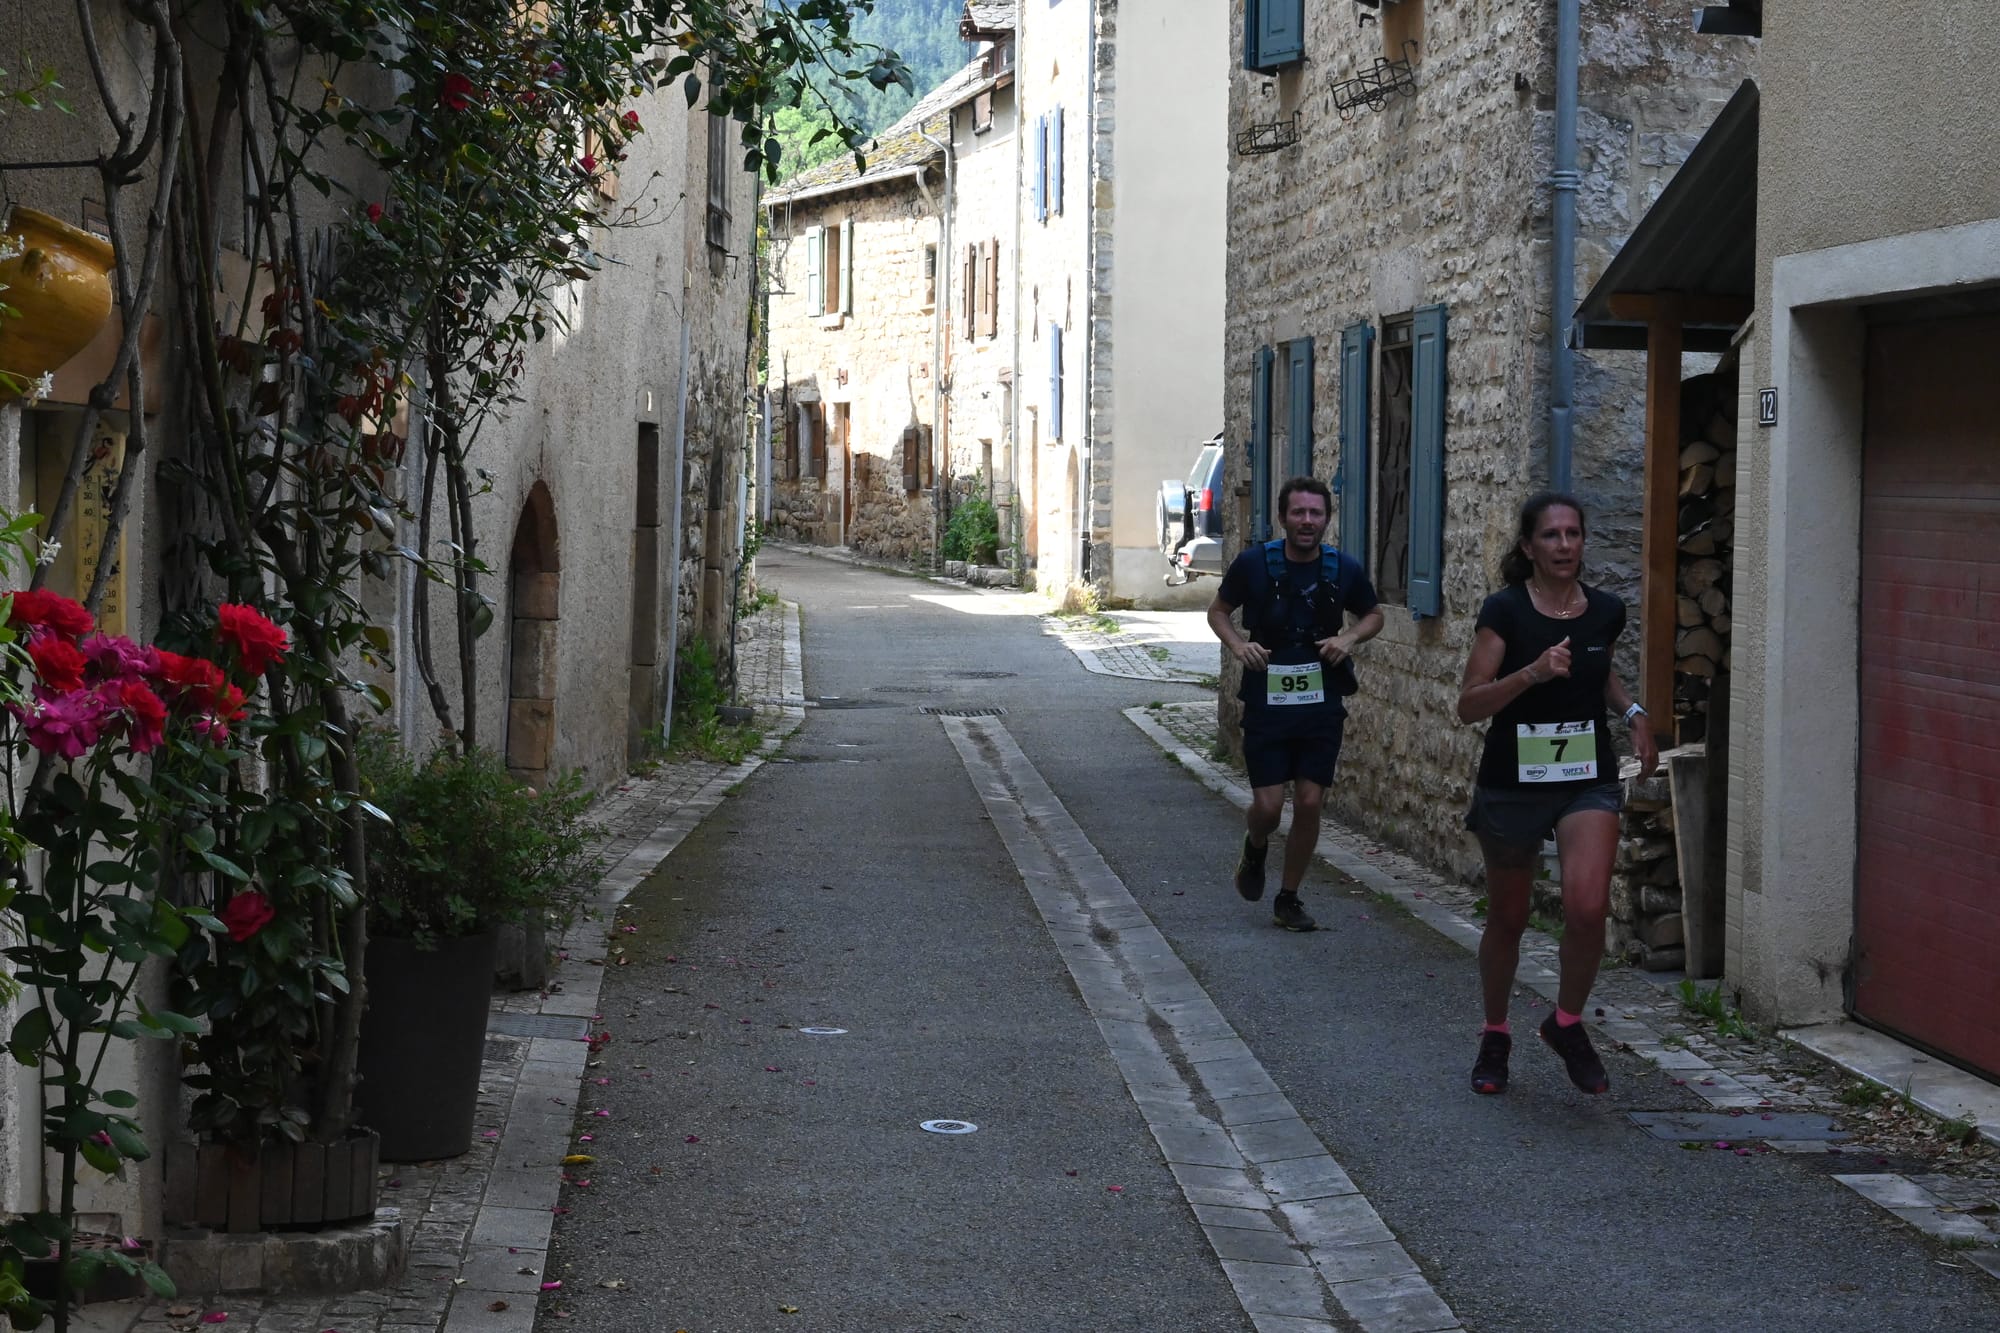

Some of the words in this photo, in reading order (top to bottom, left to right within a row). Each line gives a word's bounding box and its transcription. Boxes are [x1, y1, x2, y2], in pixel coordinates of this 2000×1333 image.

[1761, 393, 1774, 419] 12
[1282, 675, 1309, 692] 95
[1550, 739, 1569, 762] 7
